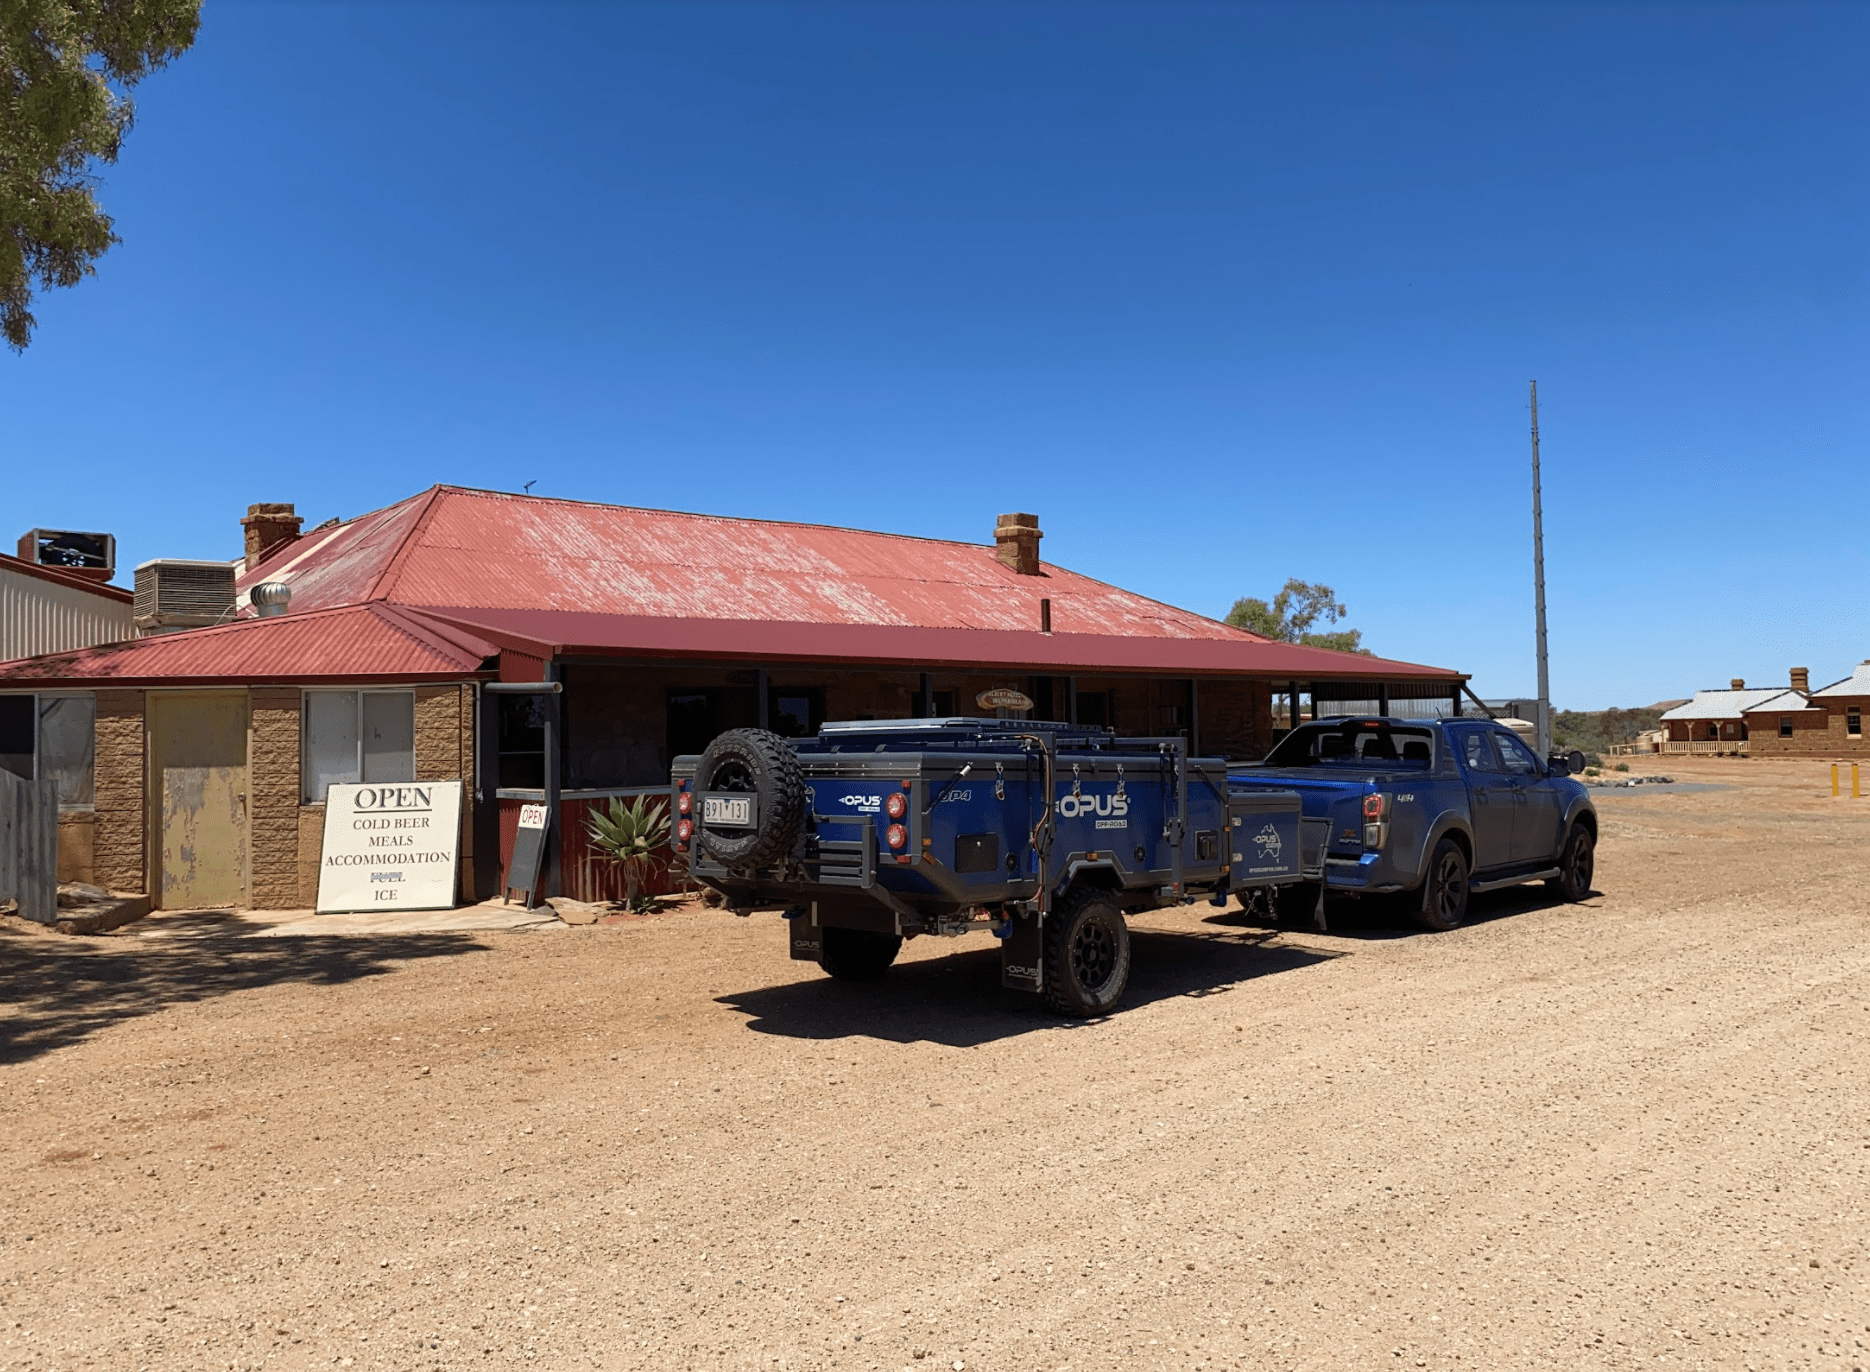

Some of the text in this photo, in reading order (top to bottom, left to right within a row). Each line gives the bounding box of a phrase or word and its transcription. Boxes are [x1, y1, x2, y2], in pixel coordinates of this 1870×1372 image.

[353, 787, 433, 809] OPEN
[844, 795, 881, 806] OPUS
[731, 802, 747, 819] 131
[1060, 794, 1128, 818] OPUS
[522, 809, 543, 824] OPEN
[353, 817, 430, 830] COLD BEER
[368, 835, 413, 847] MEALS
[1256, 835, 1277, 844] OPUS
[325, 852, 451, 867] ACCOMMODATION
[374, 889, 398, 901] ICE
[795, 940, 820, 949] OPUS
[1008, 965, 1038, 976] OPUS
